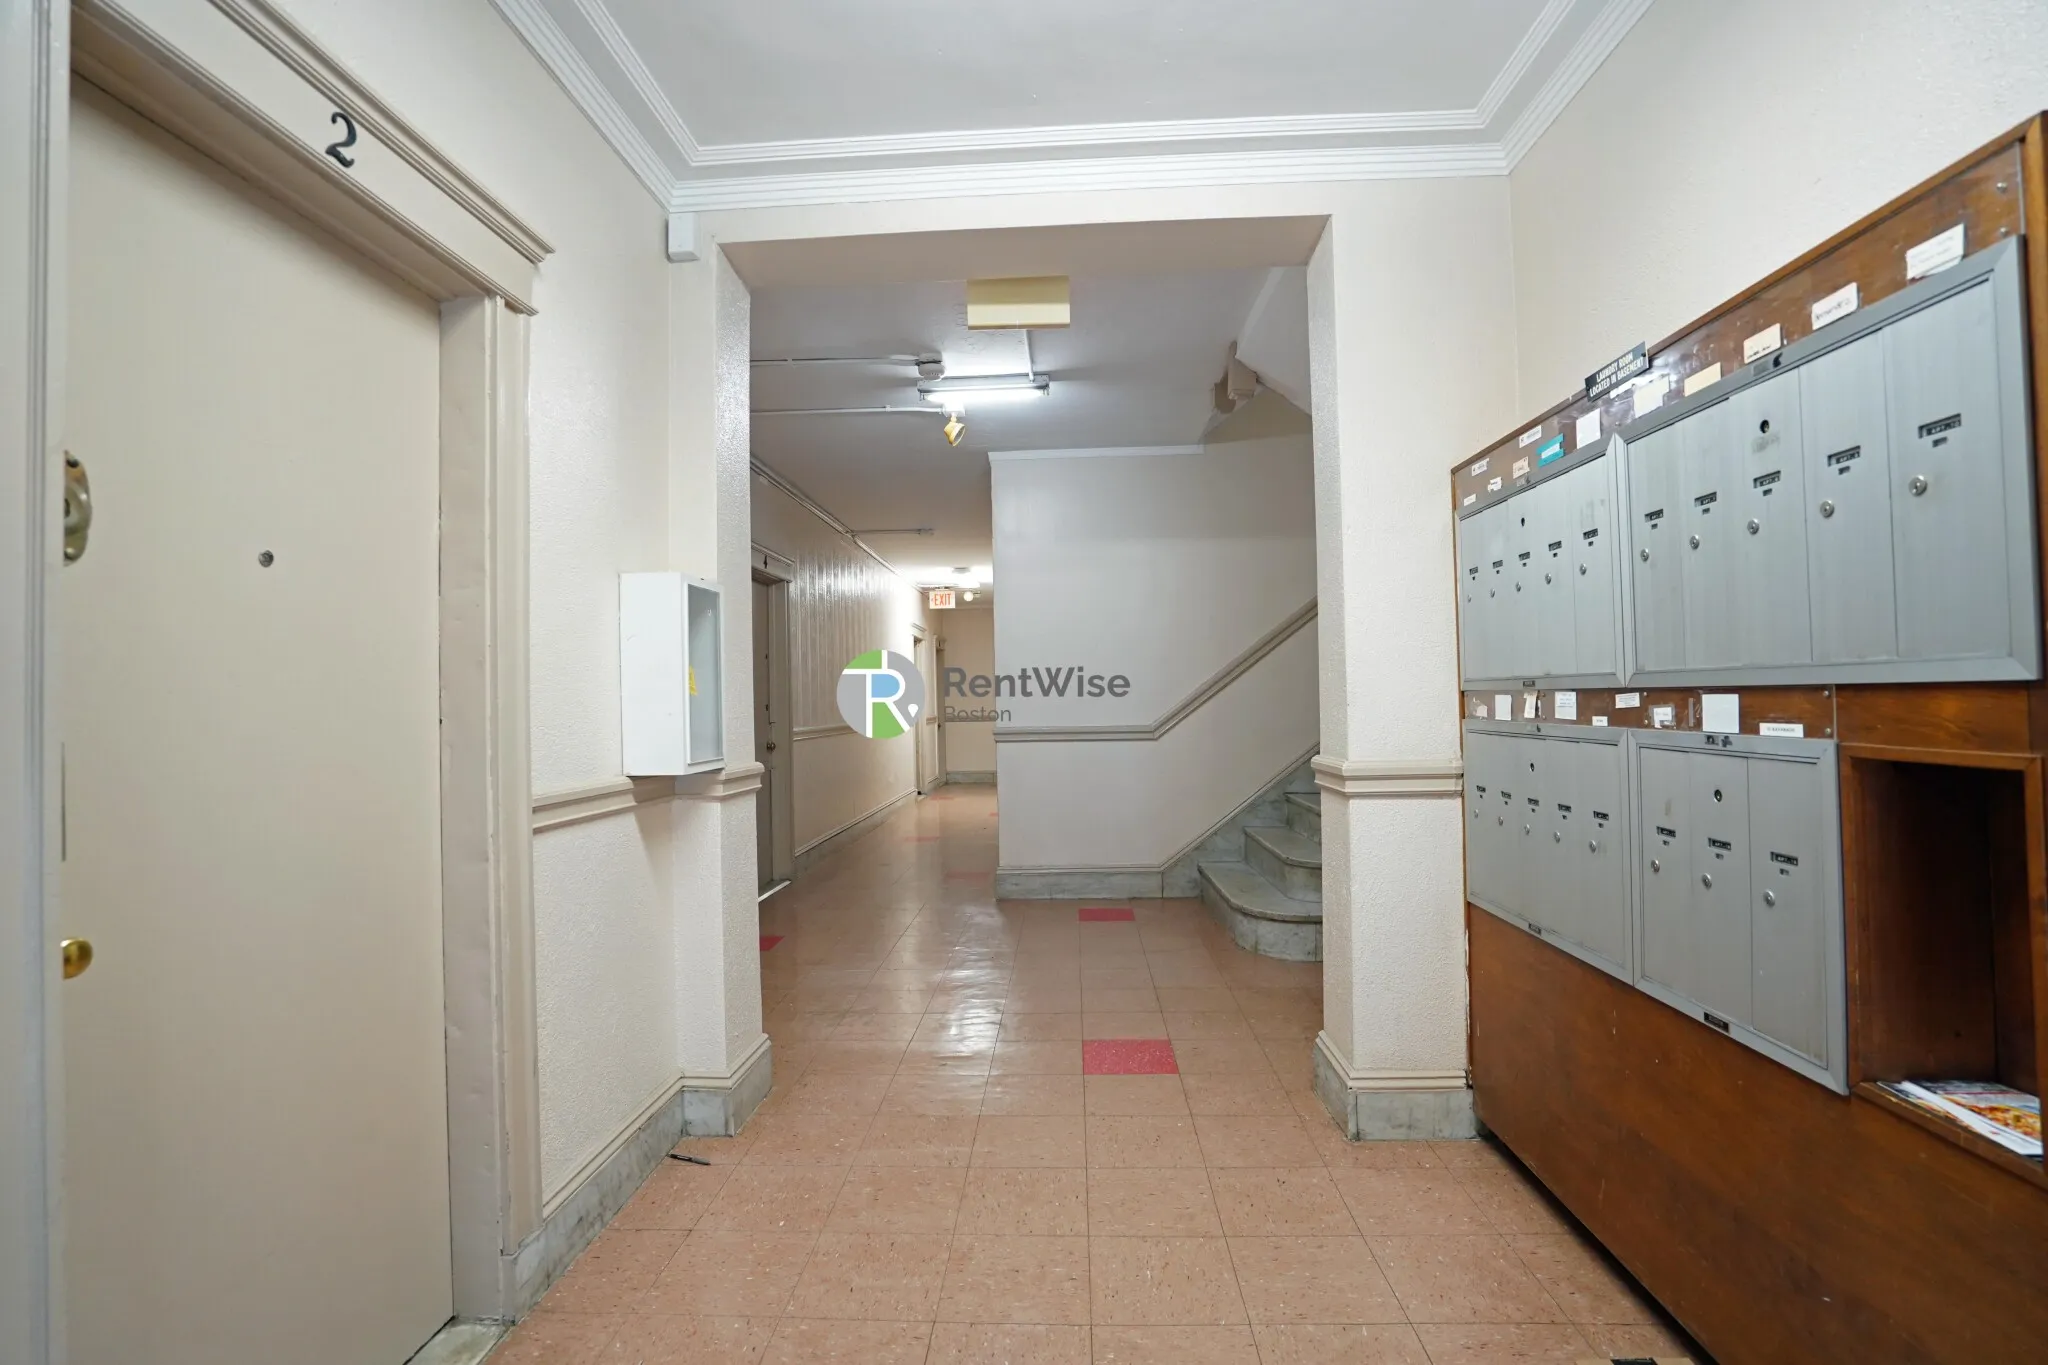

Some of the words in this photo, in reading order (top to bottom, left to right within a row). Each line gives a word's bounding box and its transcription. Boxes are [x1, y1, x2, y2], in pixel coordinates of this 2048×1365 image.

[325, 111, 357, 168] 2
[1590, 378, 1610, 397] LOCATED
[1617, 356, 1643, 380] BASEMENT
[1596, 361, 1617, 382] LAUNDRY
[1619, 352, 1633, 369] ROOM
[934, 593, 951, 606] EXIT
